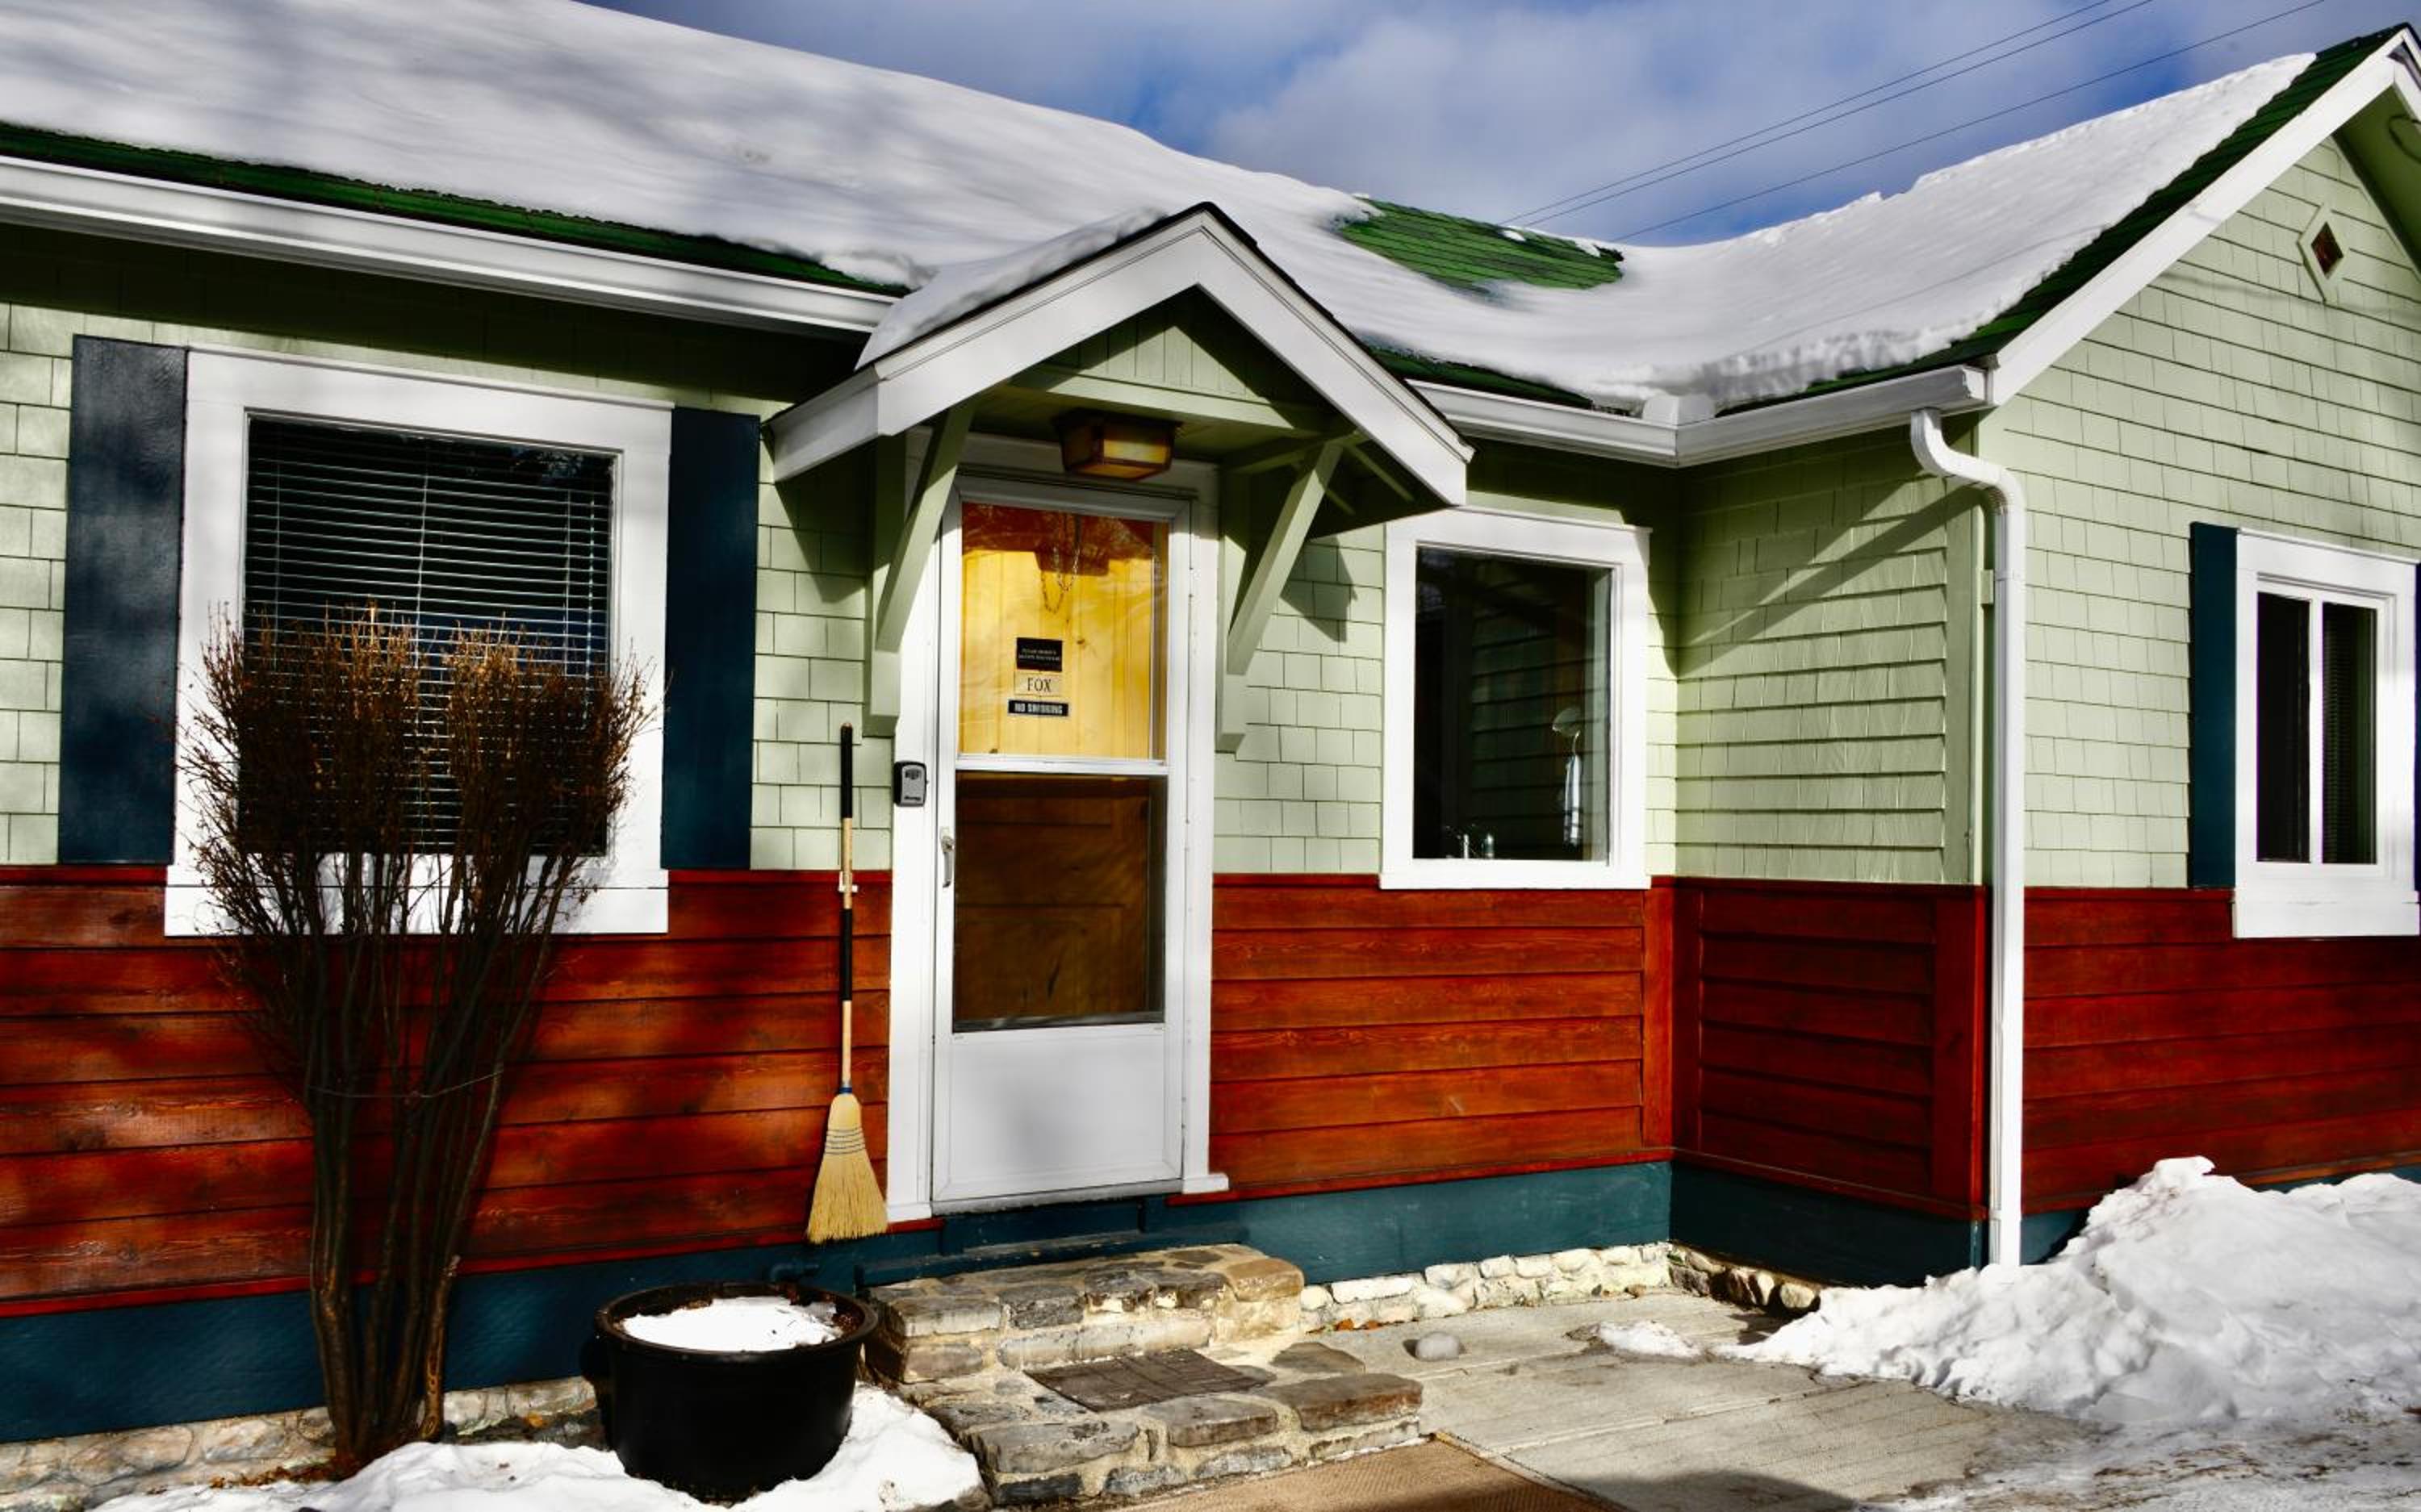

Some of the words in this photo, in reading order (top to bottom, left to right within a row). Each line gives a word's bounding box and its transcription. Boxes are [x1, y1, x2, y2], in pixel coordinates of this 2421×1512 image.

[1027, 678, 1052, 692] FOX
[1014, 703, 1026, 712] NO
[1027, 703, 1063, 715] SMOKING
